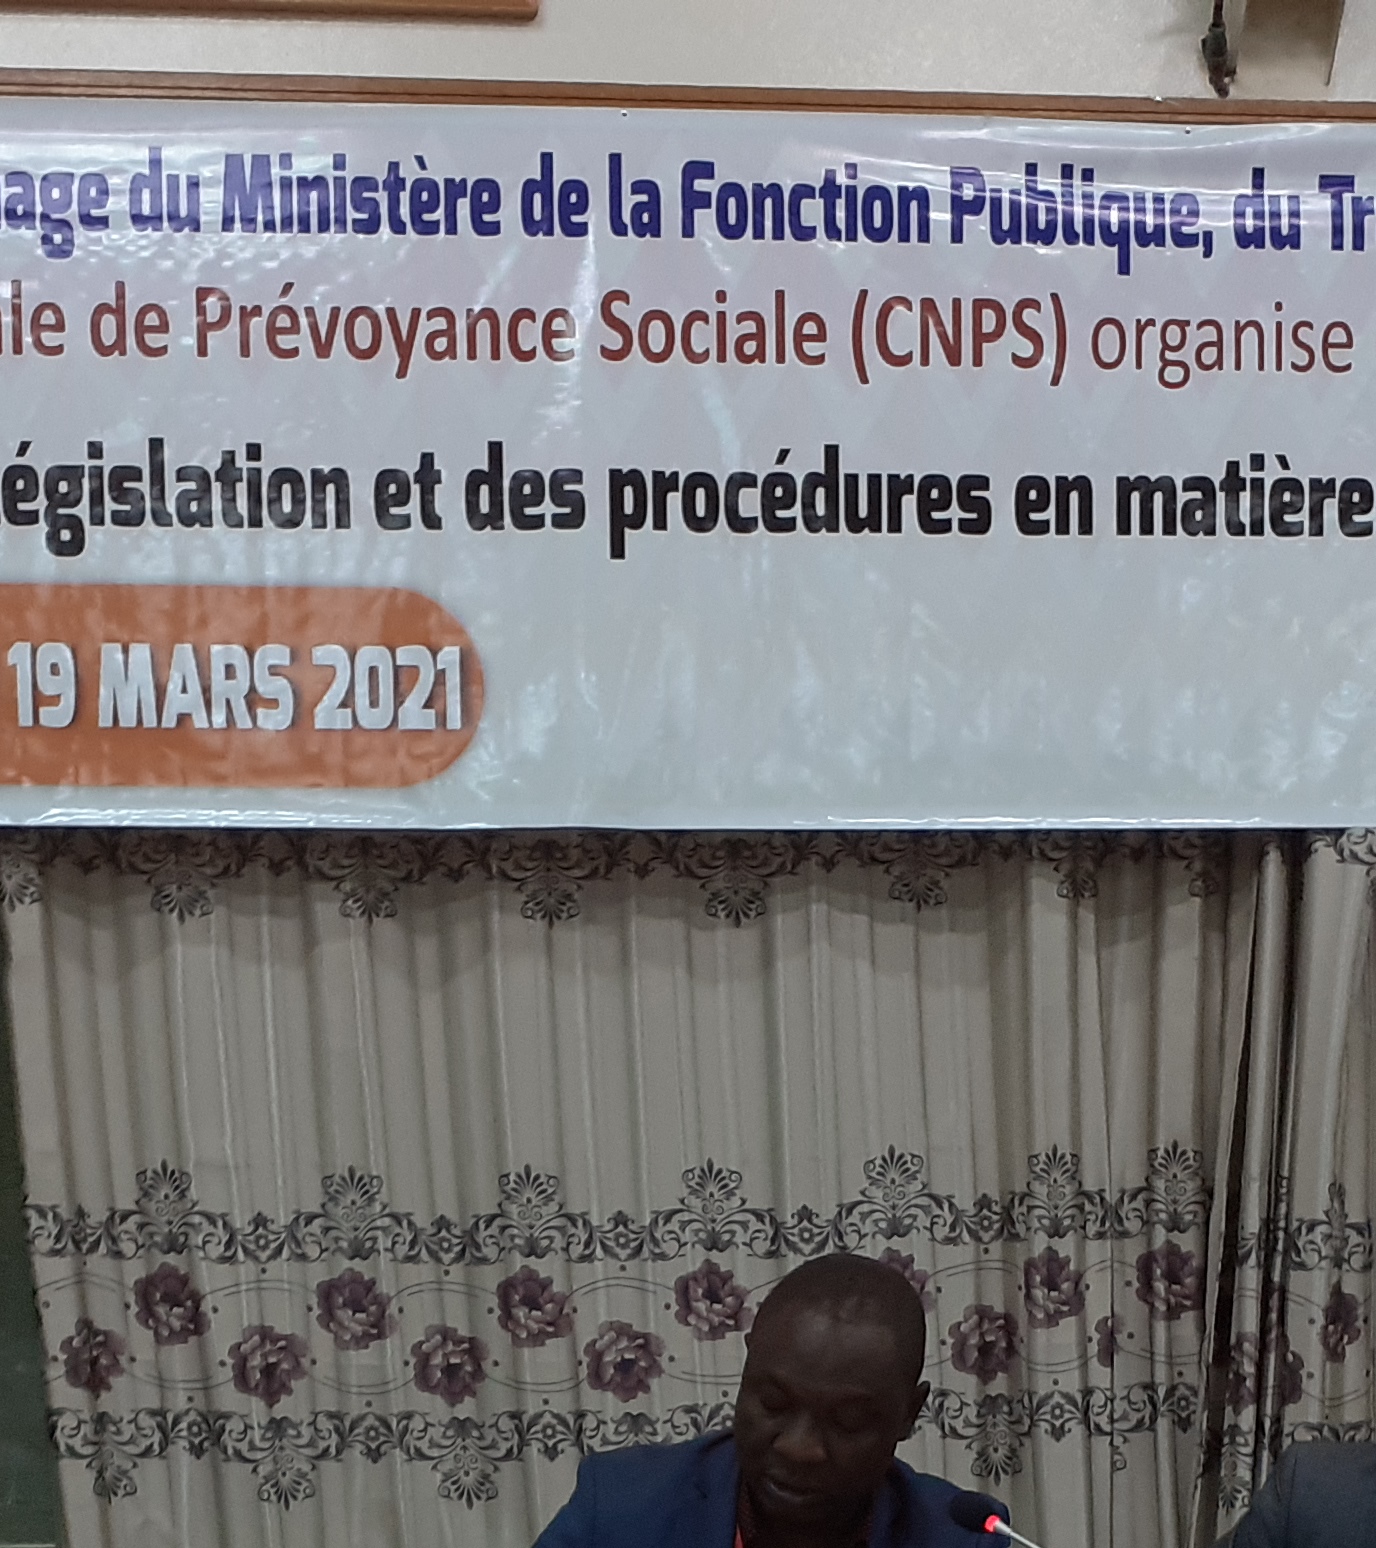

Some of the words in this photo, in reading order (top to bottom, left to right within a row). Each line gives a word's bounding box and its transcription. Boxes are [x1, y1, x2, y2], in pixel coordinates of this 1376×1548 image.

[130, 158, 200, 232] du
[221, 153, 501, 236] Ministère
[521, 152, 589, 237] de
[608, 152, 661, 238] la
[681, 160, 930, 244] Fonction
[950, 162, 1213, 276] Publique,
[1233, 167, 1301, 251] du
[90, 281, 169, 357] de
[196, 282, 574, 379] Prévoyance
[600, 289, 827, 365] Sociale
[852, 289, 1066, 386] (CNPS)
[1092, 317, 1353, 389] organise
[374, 452, 442, 530] et
[465, 441, 585, 531] des
[609, 444, 992, 560] procédures
[1015, 475, 1093, 536] en
[1116, 453, 1374, 537] matière
[8, 642, 75, 727] 19
[99, 643, 293, 731] MARS
[312, 644, 461, 729] 2021
